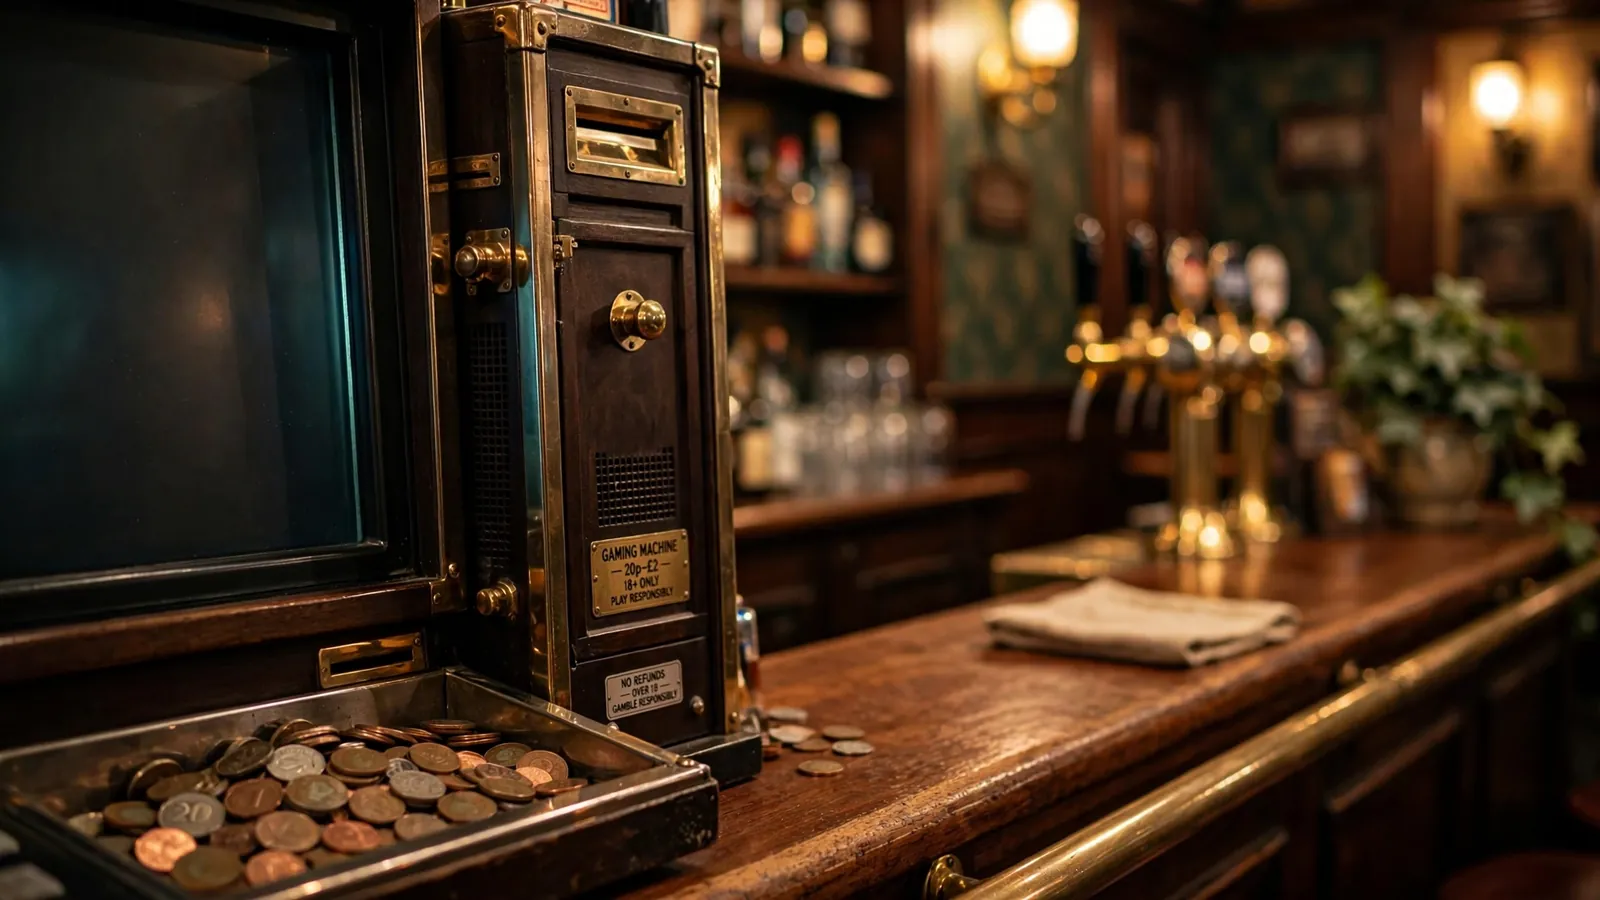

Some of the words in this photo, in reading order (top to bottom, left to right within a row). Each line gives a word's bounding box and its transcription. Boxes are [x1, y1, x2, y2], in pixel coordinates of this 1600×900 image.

[602, 545, 637, 562] GAMING
[640, 539, 678, 556] MACHINE
[624, 579, 638, 591] 18+
[639, 575, 659, 588] ONLY
[611, 594, 628, 606] PLAY
[630, 587, 673, 603] RESPONSIBLY
[621, 677, 631, 688] NO
[634, 669, 666, 685] REFUNDS
[632, 685, 649, 697] OVER
[651, 683, 658, 693] 18
[612, 700, 637, 713] GAMBLE
[176, 803, 213, 822] 20
